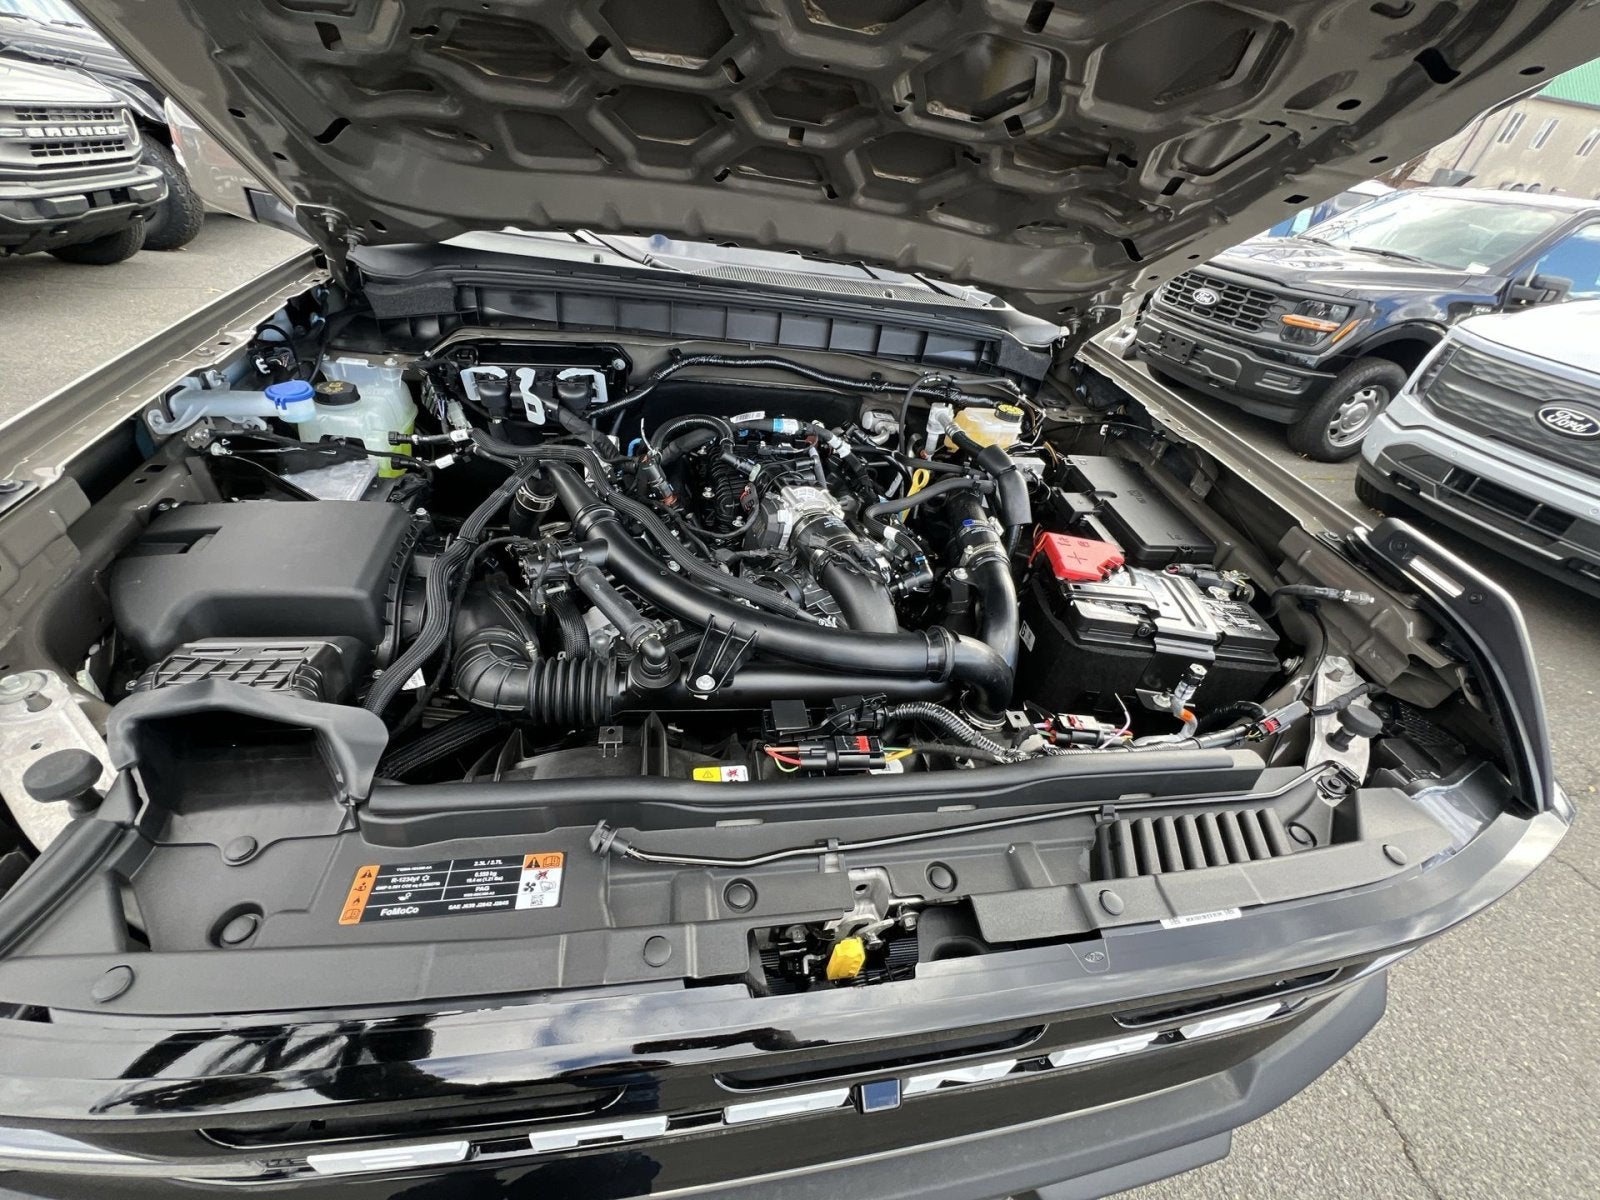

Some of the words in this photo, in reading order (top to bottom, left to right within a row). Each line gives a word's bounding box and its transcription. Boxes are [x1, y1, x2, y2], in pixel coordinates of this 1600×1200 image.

[25, 126, 120, 138] BRONCO
[1546, 410, 1593, 433] Ford
[390, 875, 421, 884] R-1234yf
[380, 906, 420, 917] FoMoCo
